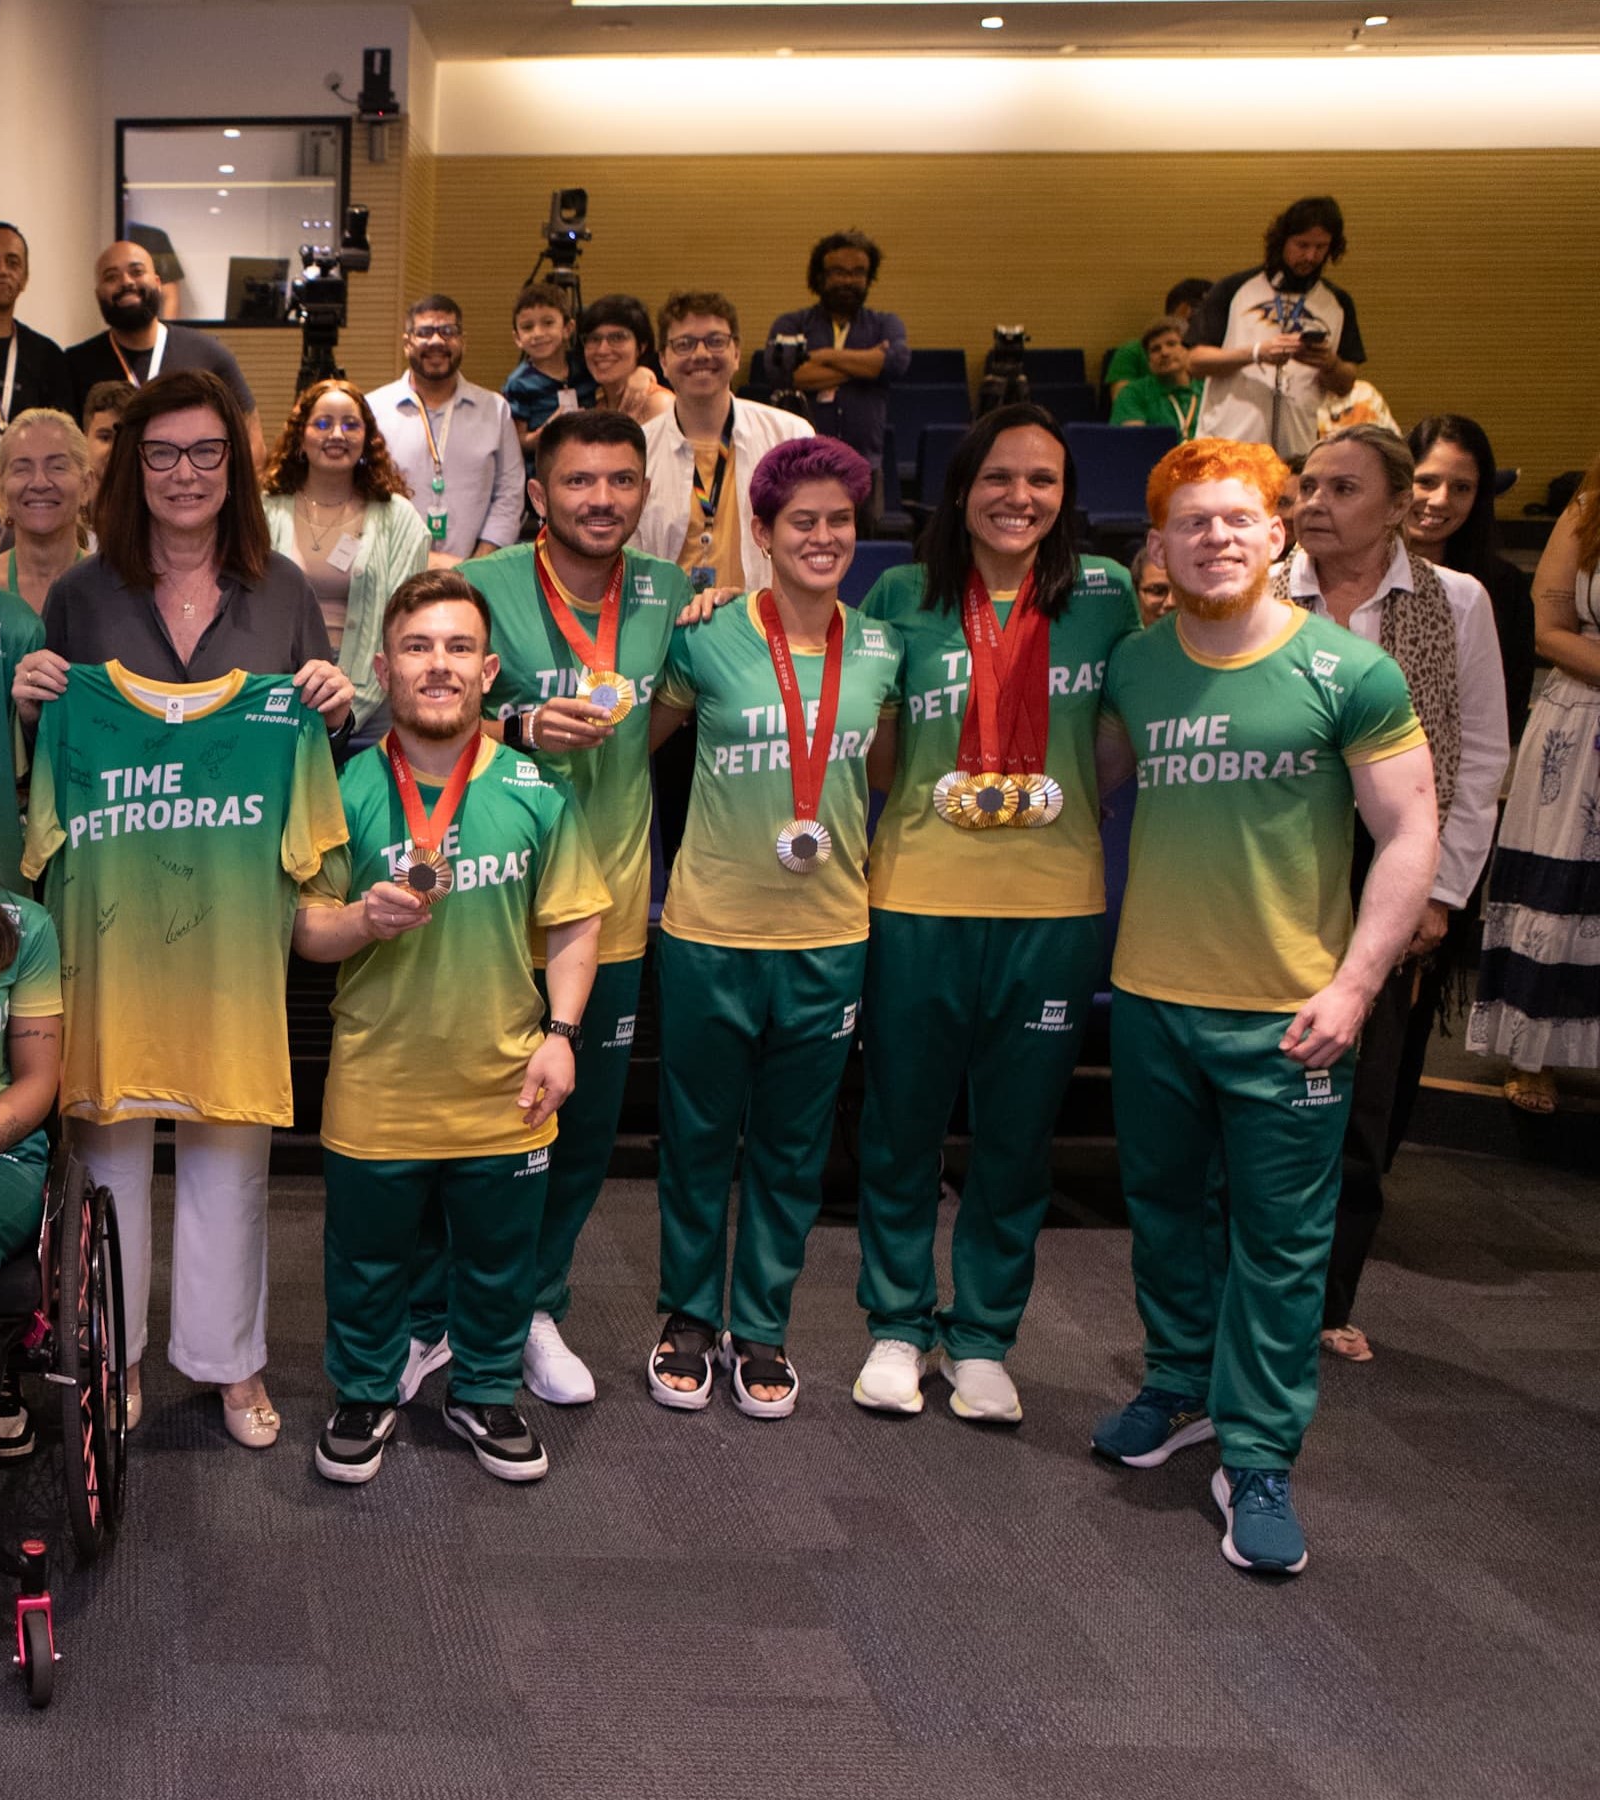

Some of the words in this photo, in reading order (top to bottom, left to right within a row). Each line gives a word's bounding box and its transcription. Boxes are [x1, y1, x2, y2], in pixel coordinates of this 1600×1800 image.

[772, 636, 786, 663] 2024
[778, 663, 792, 691] PARIS
[244, 713, 300, 727] PETROBRAS
[1145, 713, 1231, 752] TIME
[100, 762, 184, 801] TIME
[69, 794, 265, 850] PETROBRAS
